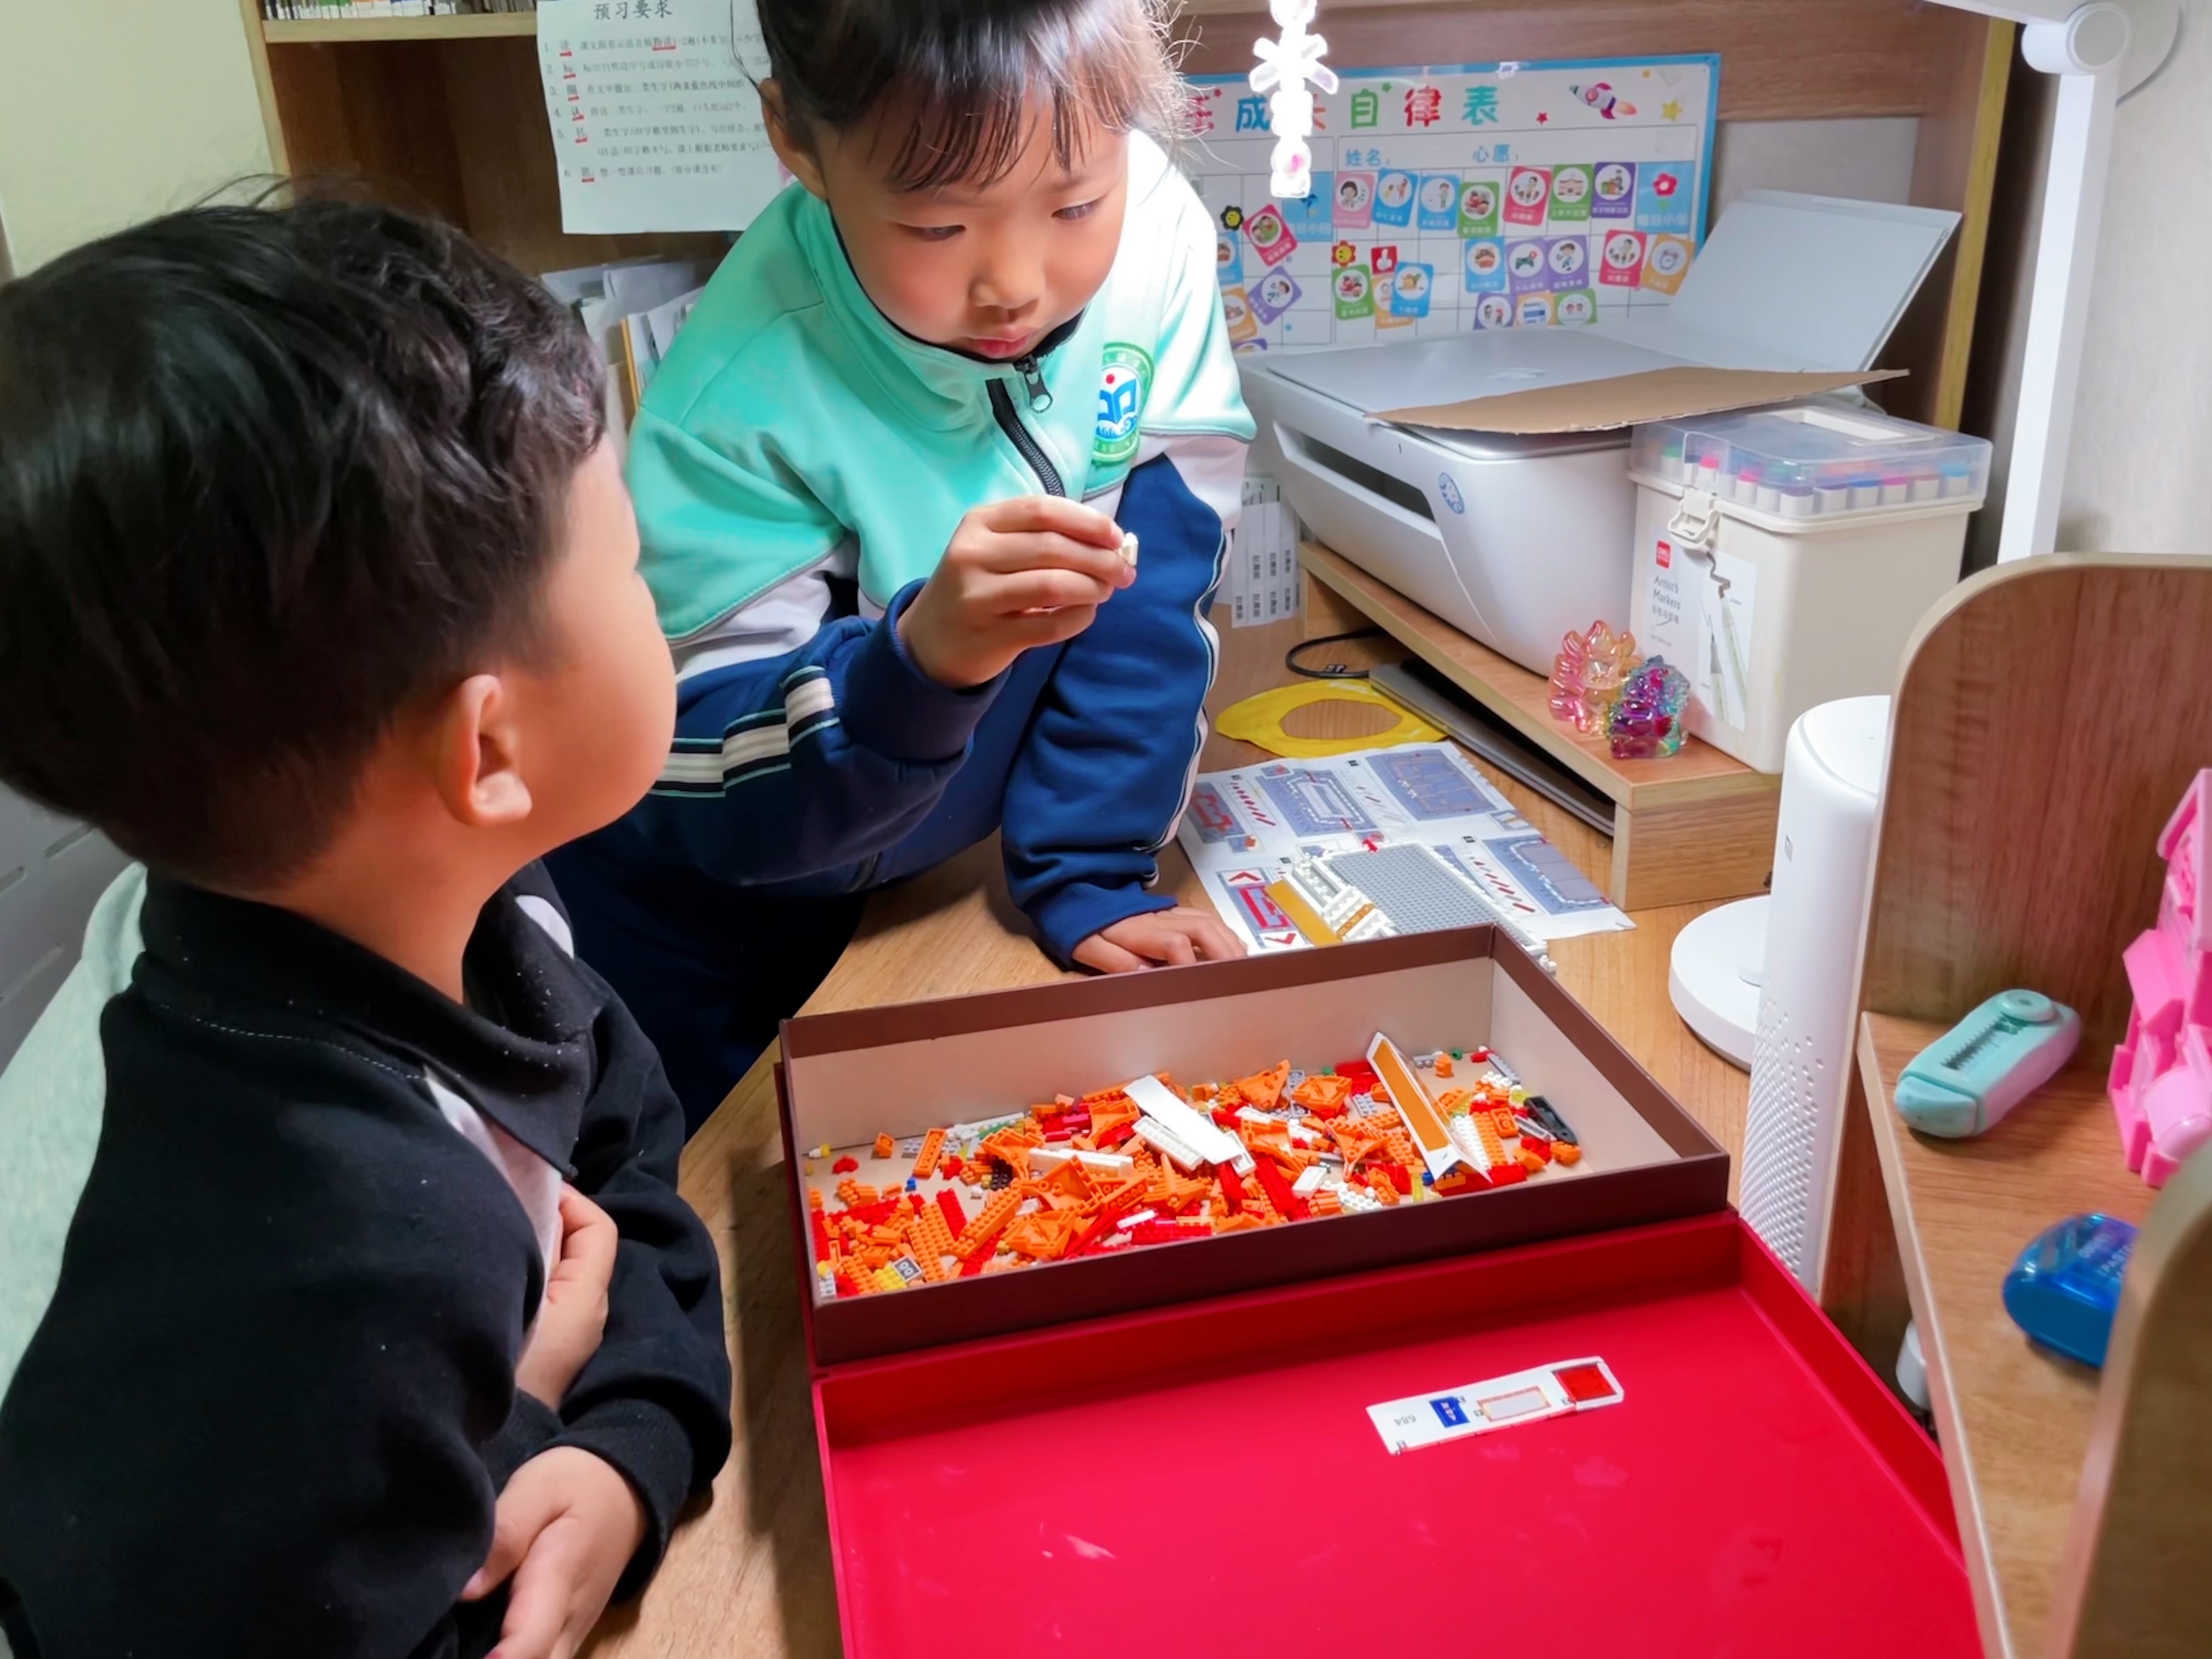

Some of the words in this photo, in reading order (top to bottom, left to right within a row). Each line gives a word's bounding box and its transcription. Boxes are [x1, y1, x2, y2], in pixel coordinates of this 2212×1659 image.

[594, 0, 673, 20] 预习要求
[1652, 588, 1681, 610] Markers
